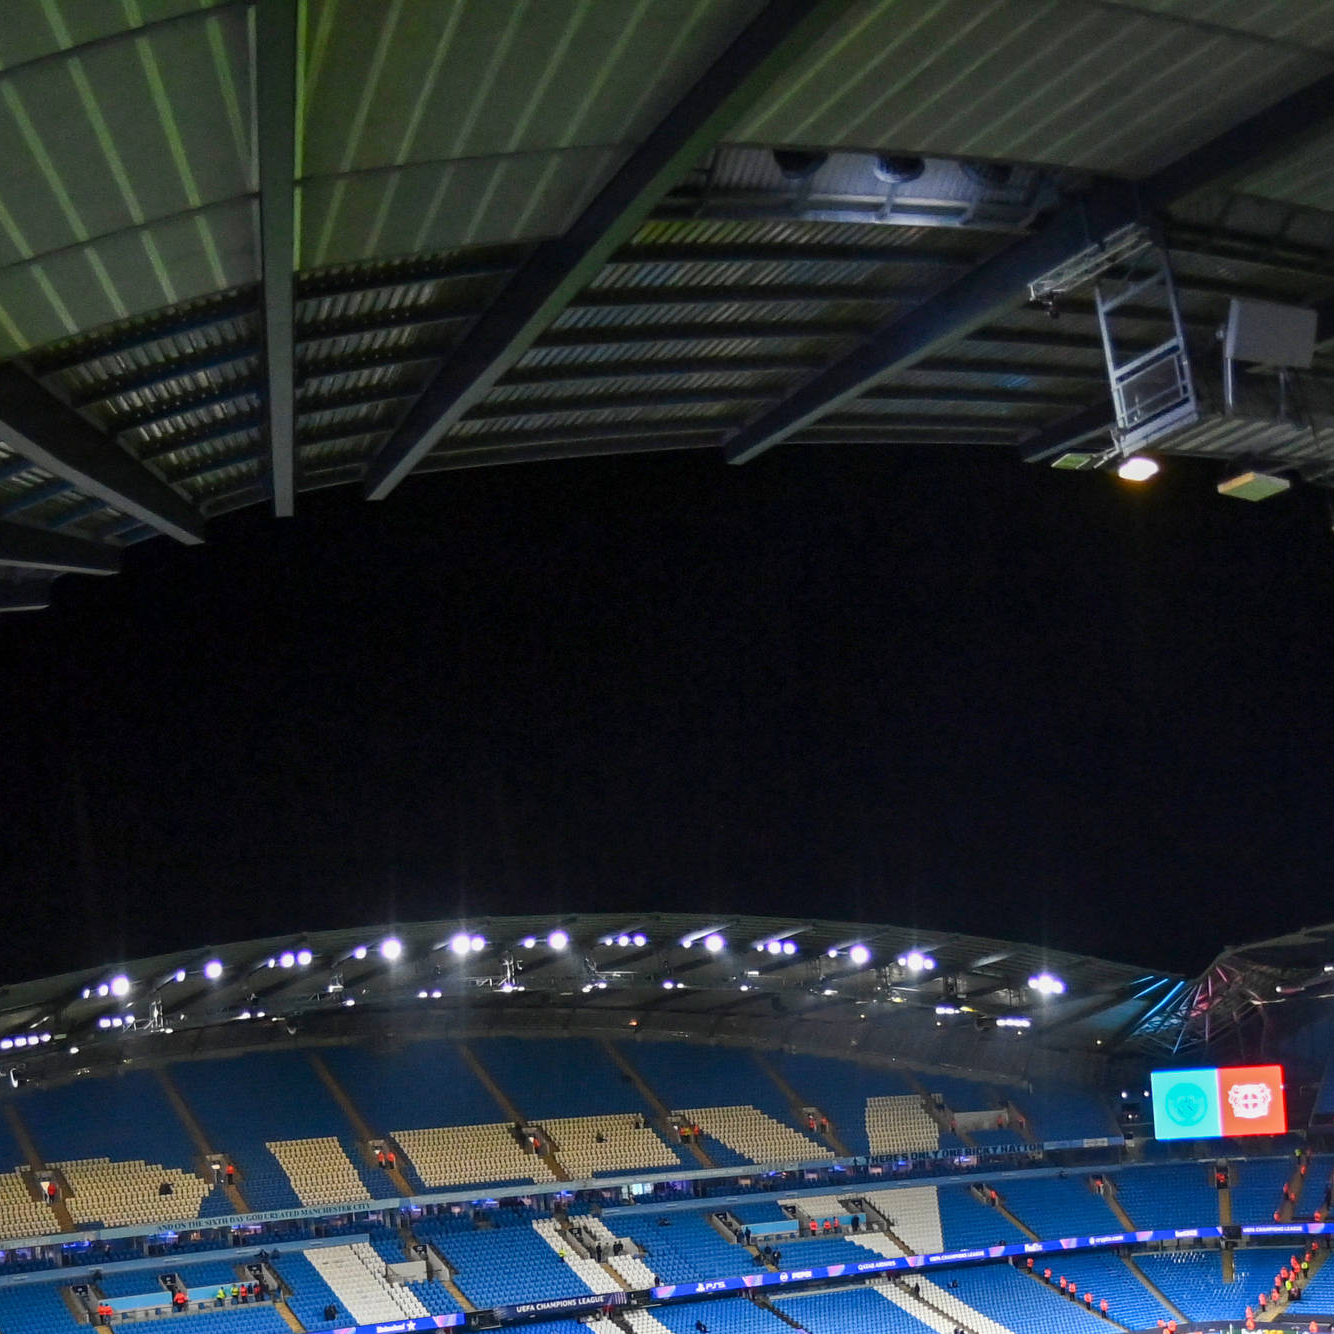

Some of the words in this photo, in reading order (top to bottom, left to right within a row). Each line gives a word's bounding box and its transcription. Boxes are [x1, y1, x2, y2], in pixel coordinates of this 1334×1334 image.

[516, 1304, 535, 1313] UEFA
[536, 1299, 577, 1311] CHAMPIONS
[578, 1295, 604, 1306] LEAGUE
